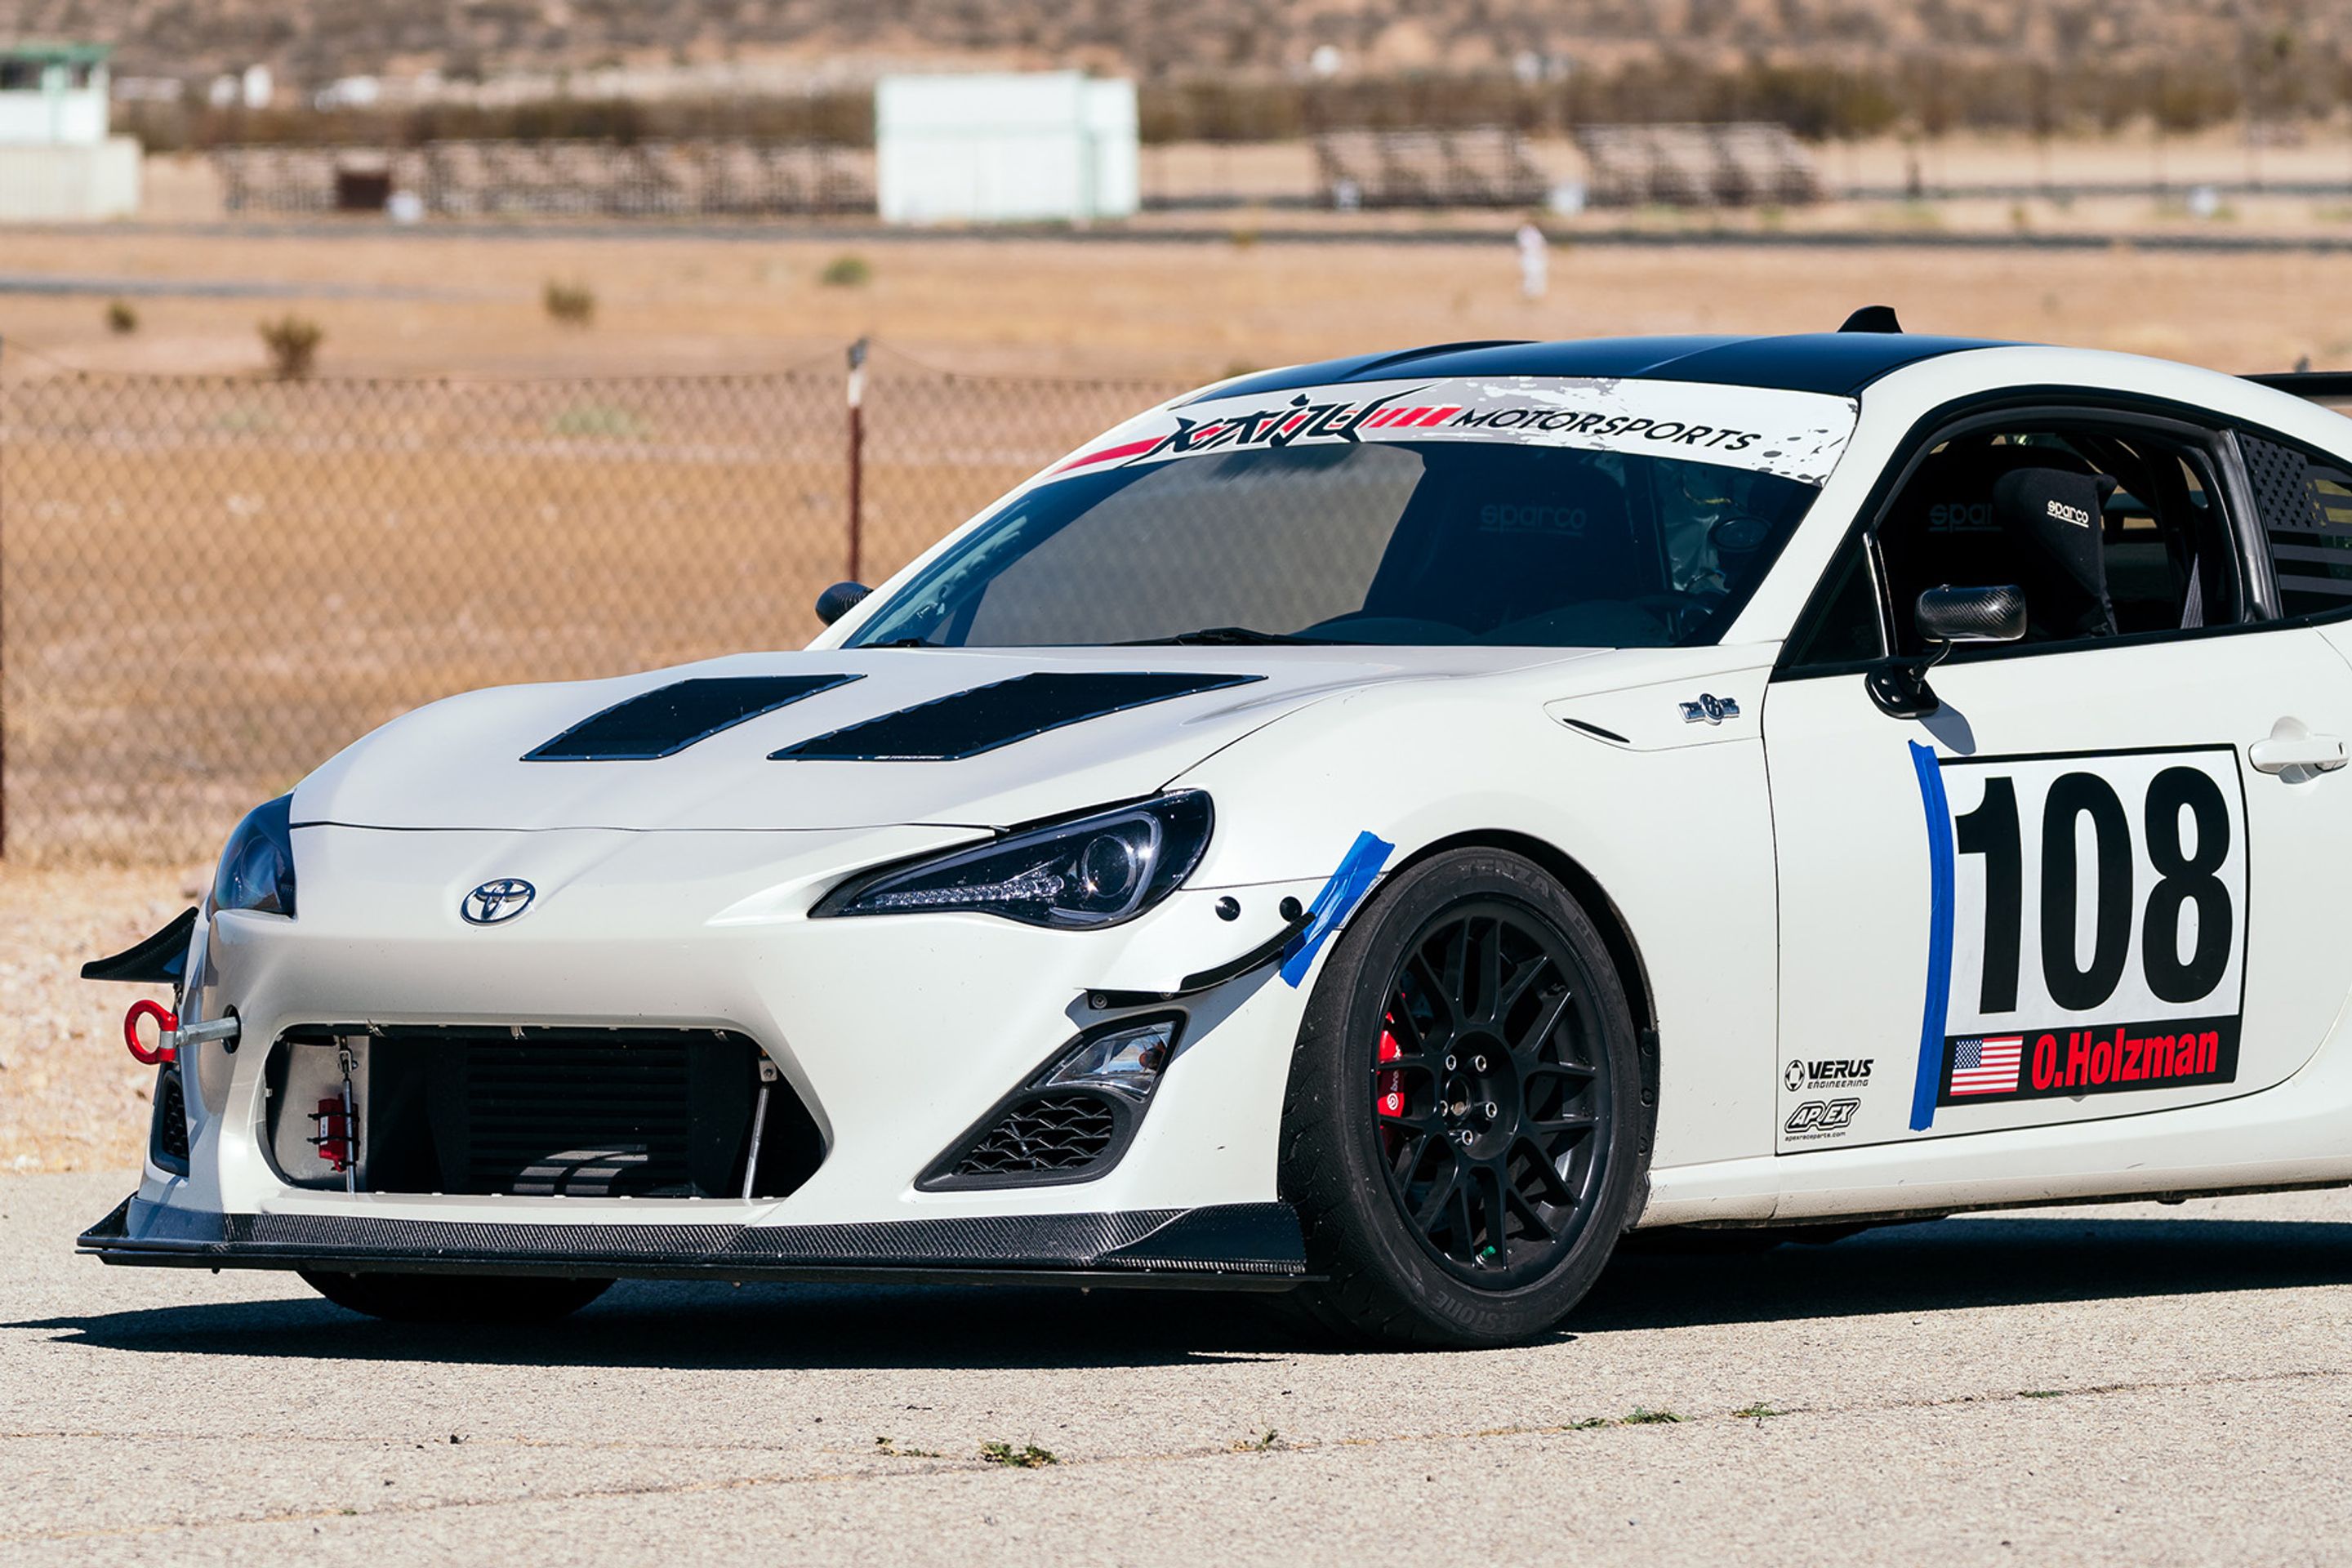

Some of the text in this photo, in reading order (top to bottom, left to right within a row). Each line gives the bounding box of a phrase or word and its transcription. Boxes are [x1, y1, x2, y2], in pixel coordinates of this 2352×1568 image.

[1450, 408, 1762, 451] MOTORSPORTS
[1480, 503, 1588, 535] sparco
[2047, 499, 2090, 526] sparco
[1955, 765, 2233, 1015] 108
[1807, 1059, 1874, 1079] VERUS
[2031, 1028, 2220, 1090] O.Holzman
[1807, 1079, 1869, 1089] ENGINEERING
[1787, 1102, 1858, 1129] APEX
